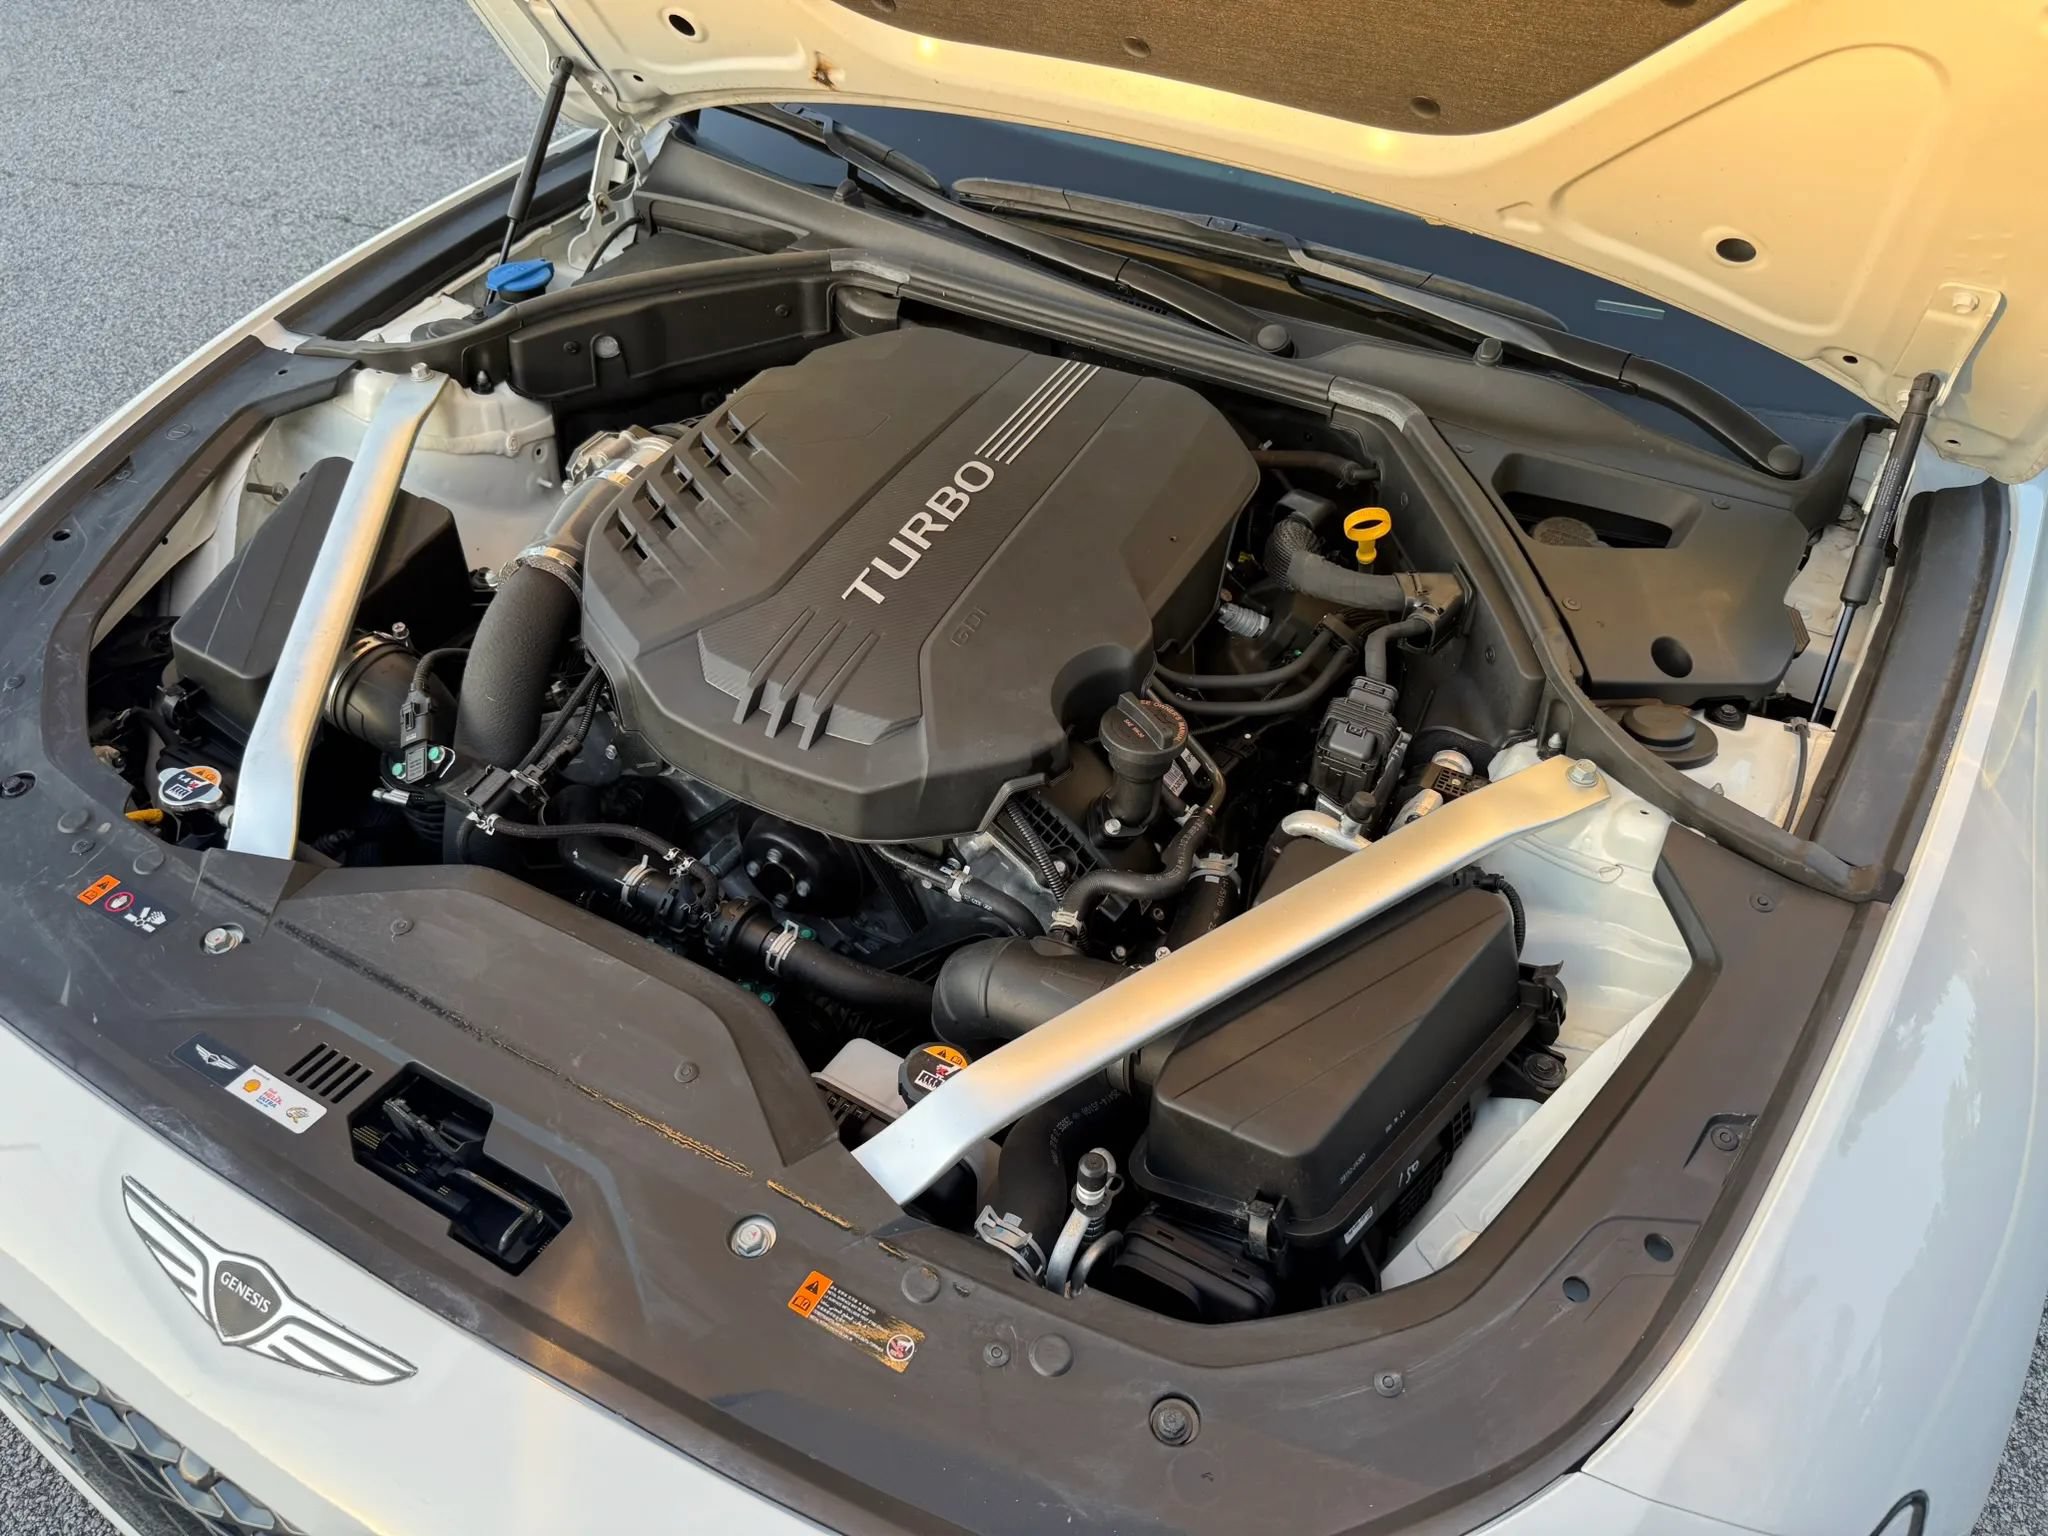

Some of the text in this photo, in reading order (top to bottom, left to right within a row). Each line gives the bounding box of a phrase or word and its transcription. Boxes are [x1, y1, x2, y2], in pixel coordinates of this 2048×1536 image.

[841, 460, 994, 604] TURBO
[951, 607, 988, 647] GDI
[220, 1271, 271, 1313] GENESIS
